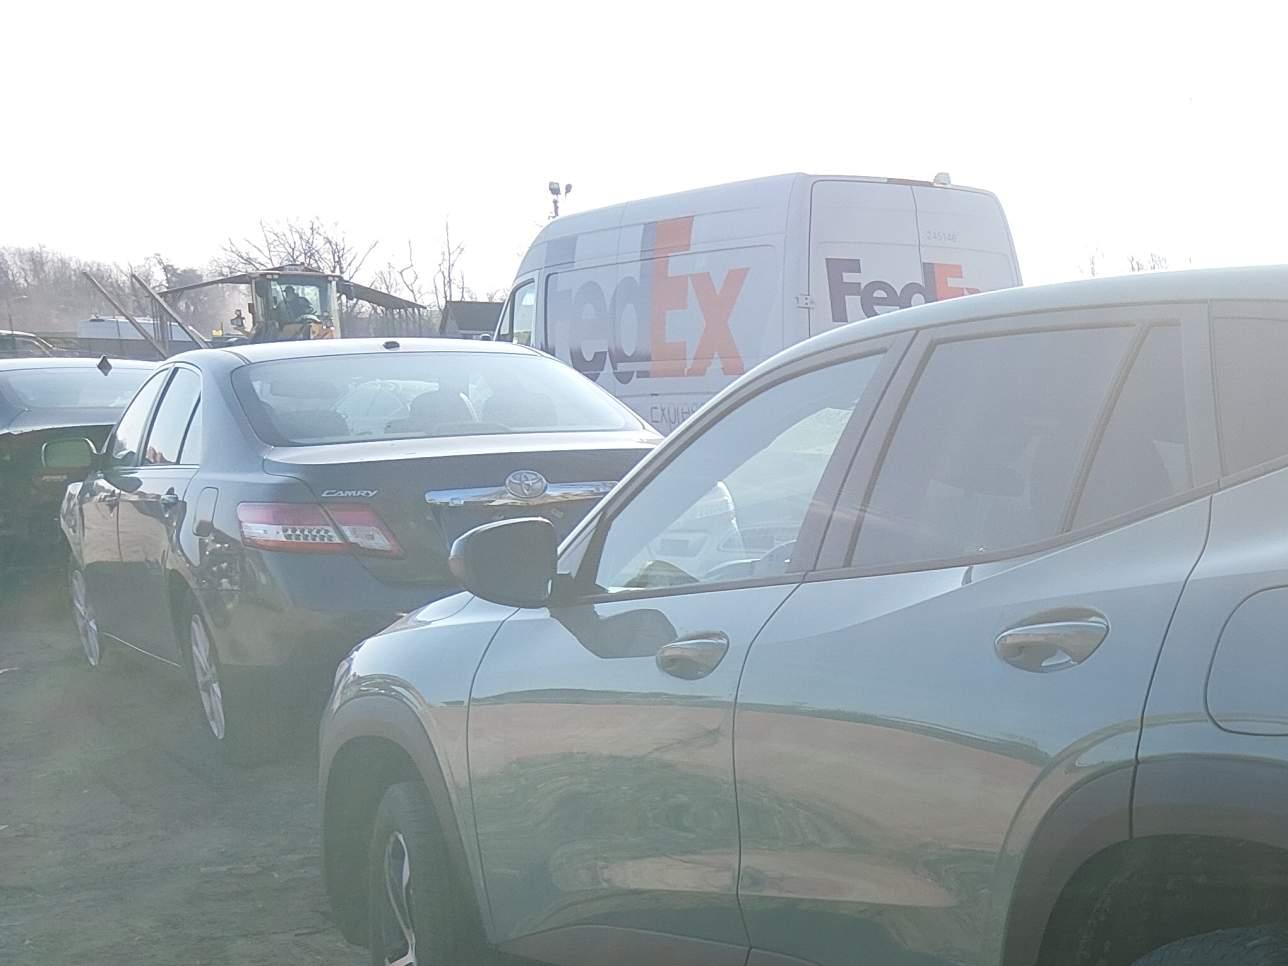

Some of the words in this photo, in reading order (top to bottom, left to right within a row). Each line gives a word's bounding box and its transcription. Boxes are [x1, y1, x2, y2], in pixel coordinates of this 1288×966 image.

[544, 216, 751, 384] FedEx
[825, 257, 982, 323] FedE
[321, 489, 378, 497] CAMRY
